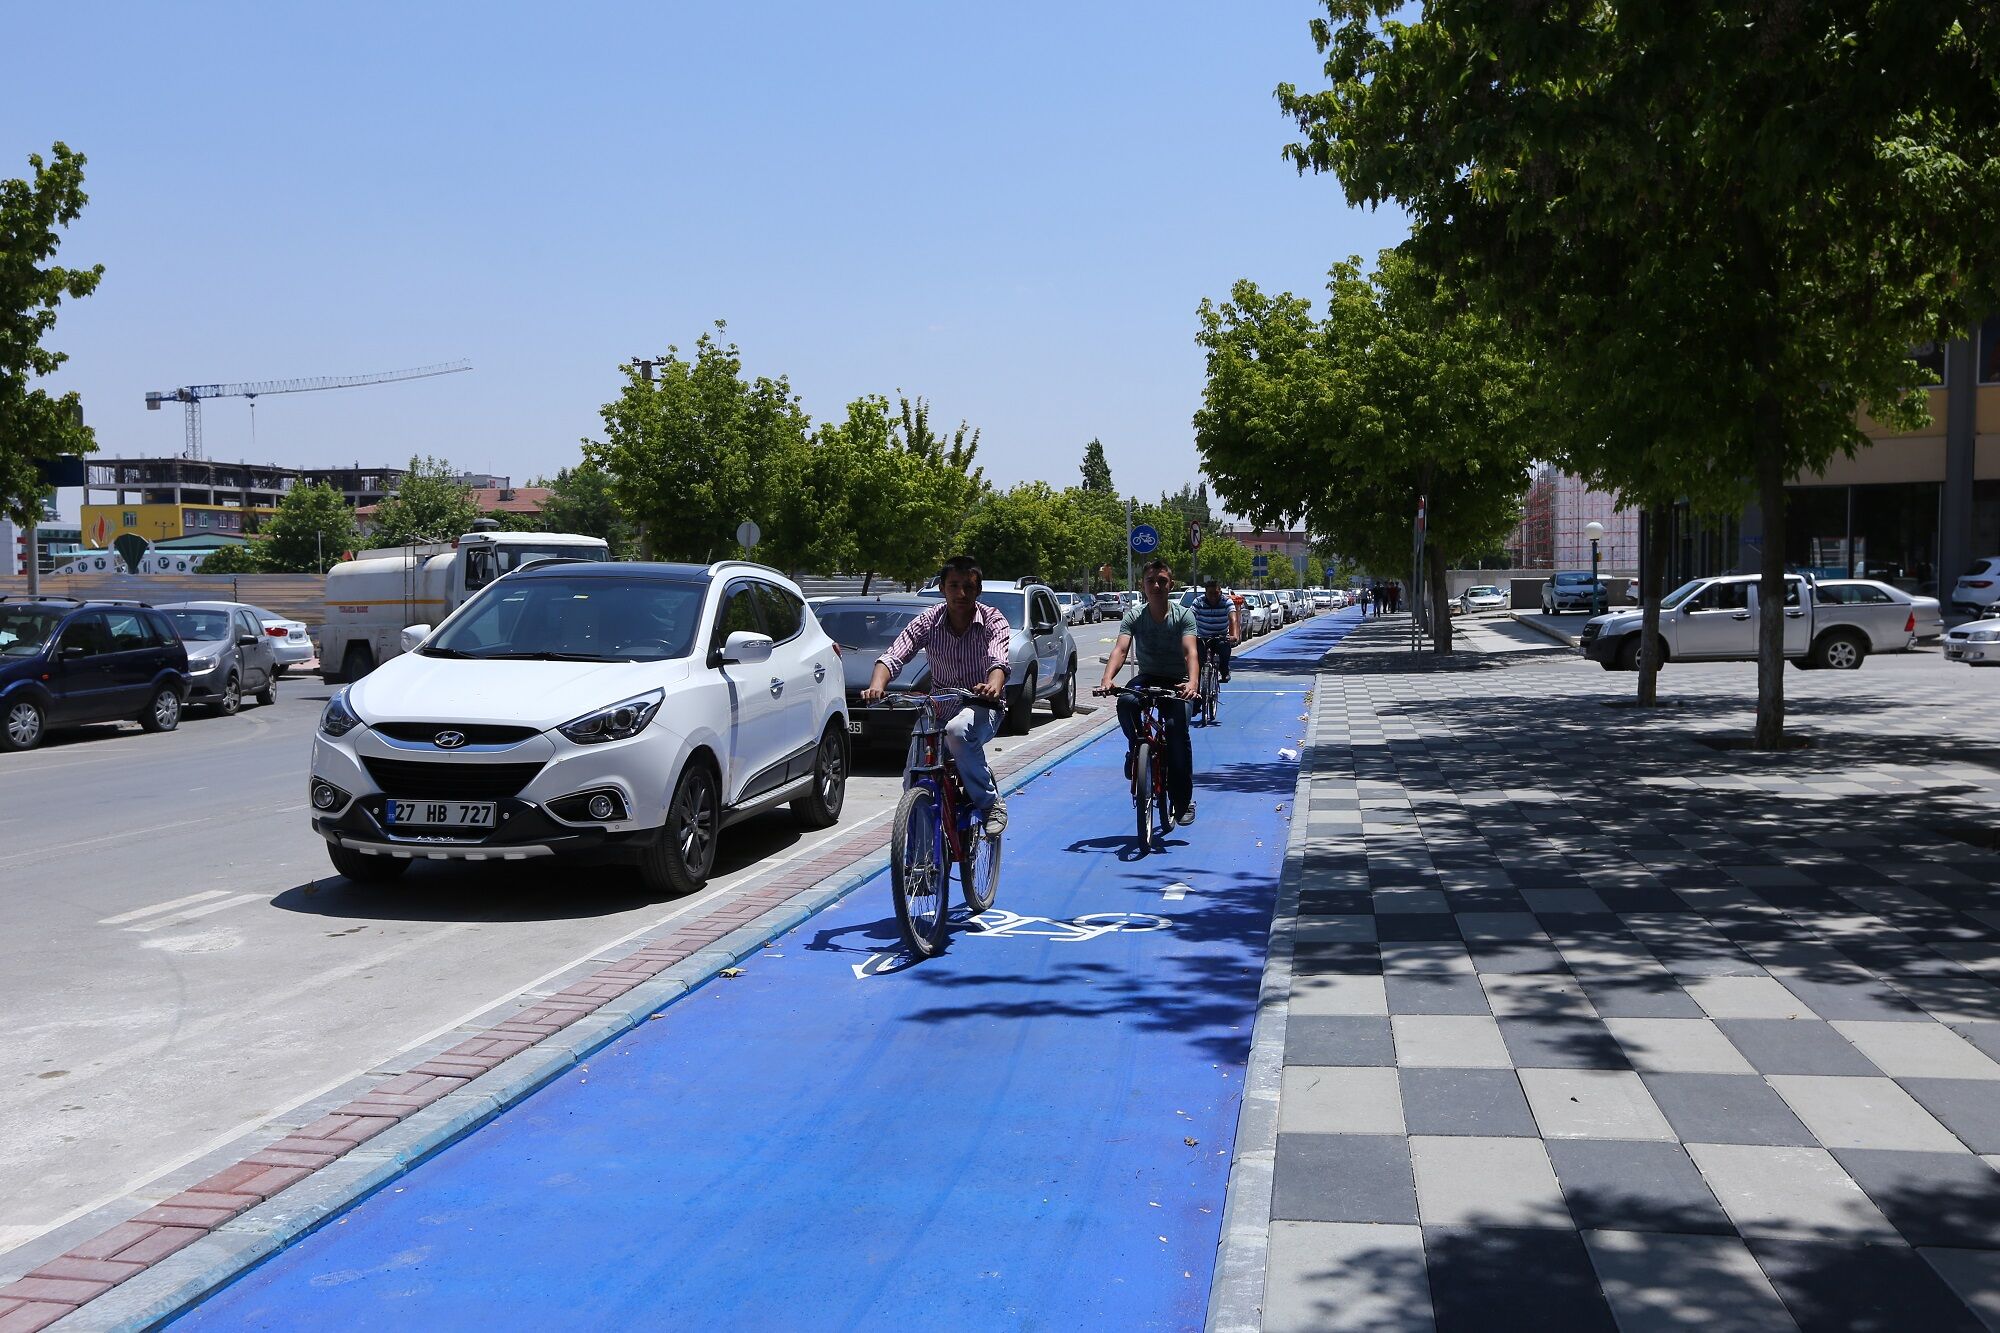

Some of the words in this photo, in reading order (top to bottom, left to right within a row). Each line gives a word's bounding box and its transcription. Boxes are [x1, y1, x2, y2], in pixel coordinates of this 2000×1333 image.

[396, 804, 415, 821] 27
[427, 804, 447, 822] HB
[460, 805, 491, 824] 727
